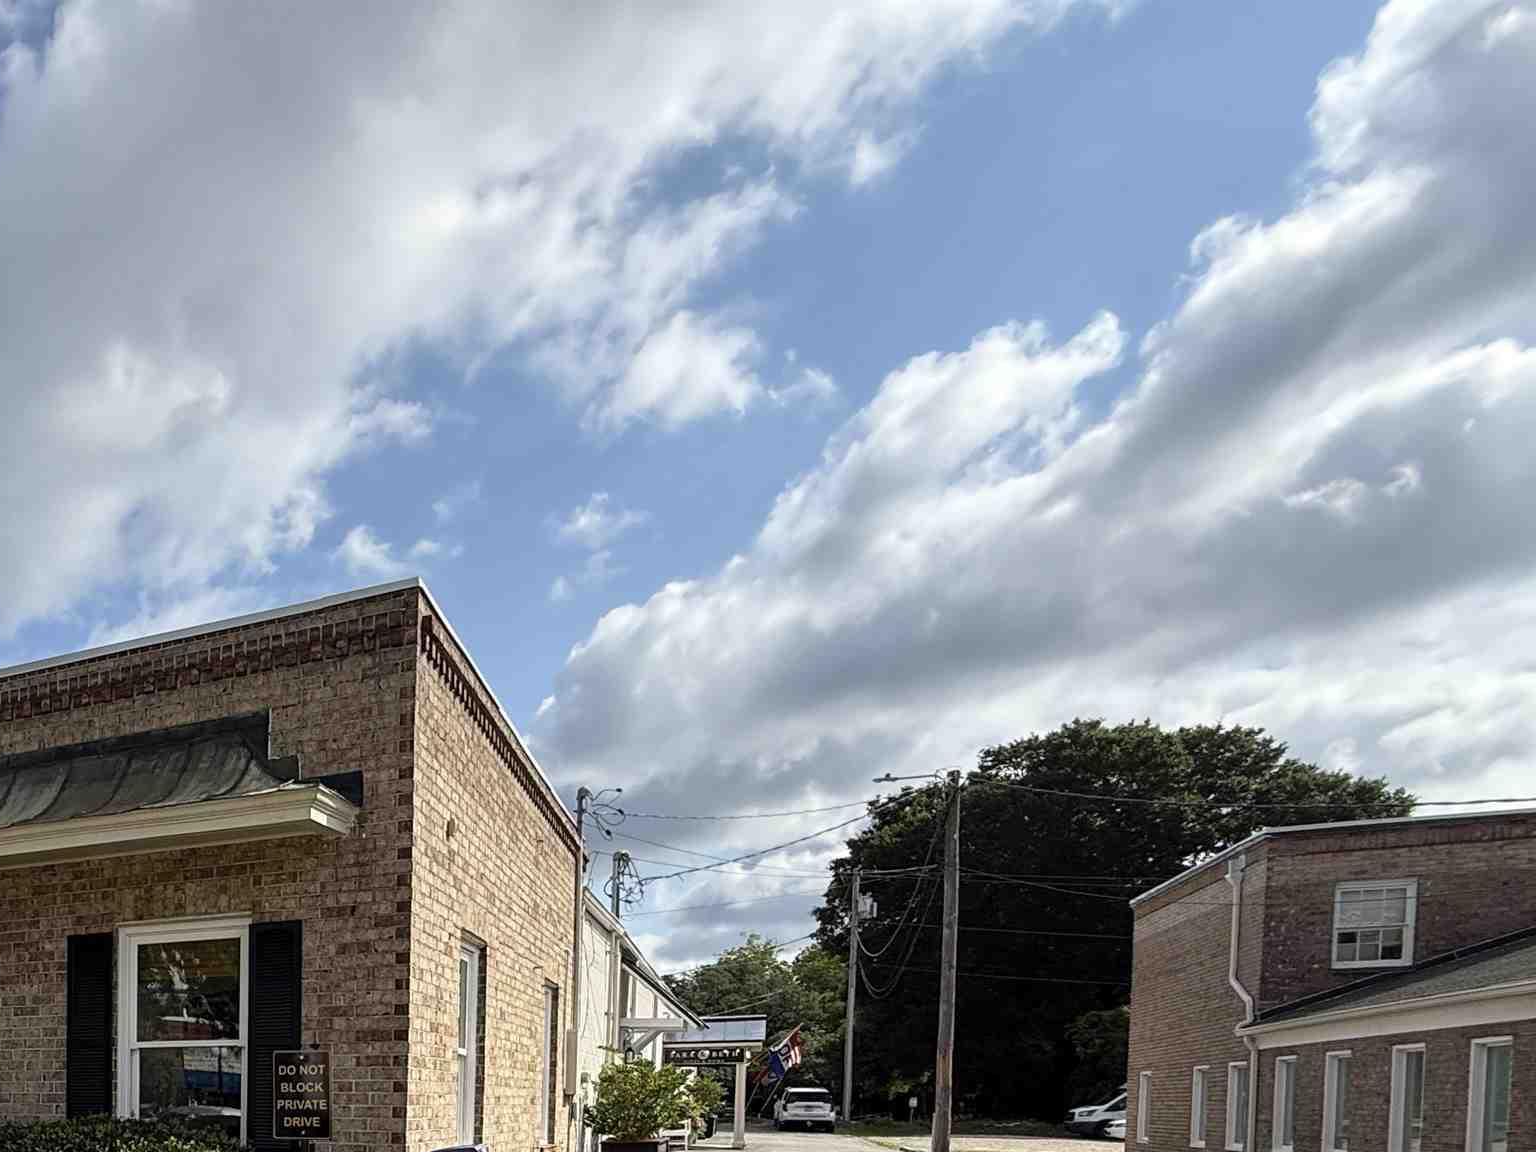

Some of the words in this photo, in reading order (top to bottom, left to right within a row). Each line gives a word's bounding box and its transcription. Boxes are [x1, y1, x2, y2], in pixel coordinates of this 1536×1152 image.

[278, 1065, 297, 1076] DO
[299, 1065, 325, 1076] NOT
[280, 1082, 324, 1093] BLOCK
[276, 1099, 328, 1110] PRIVATE
[283, 1117, 321, 1127] DRIVE
